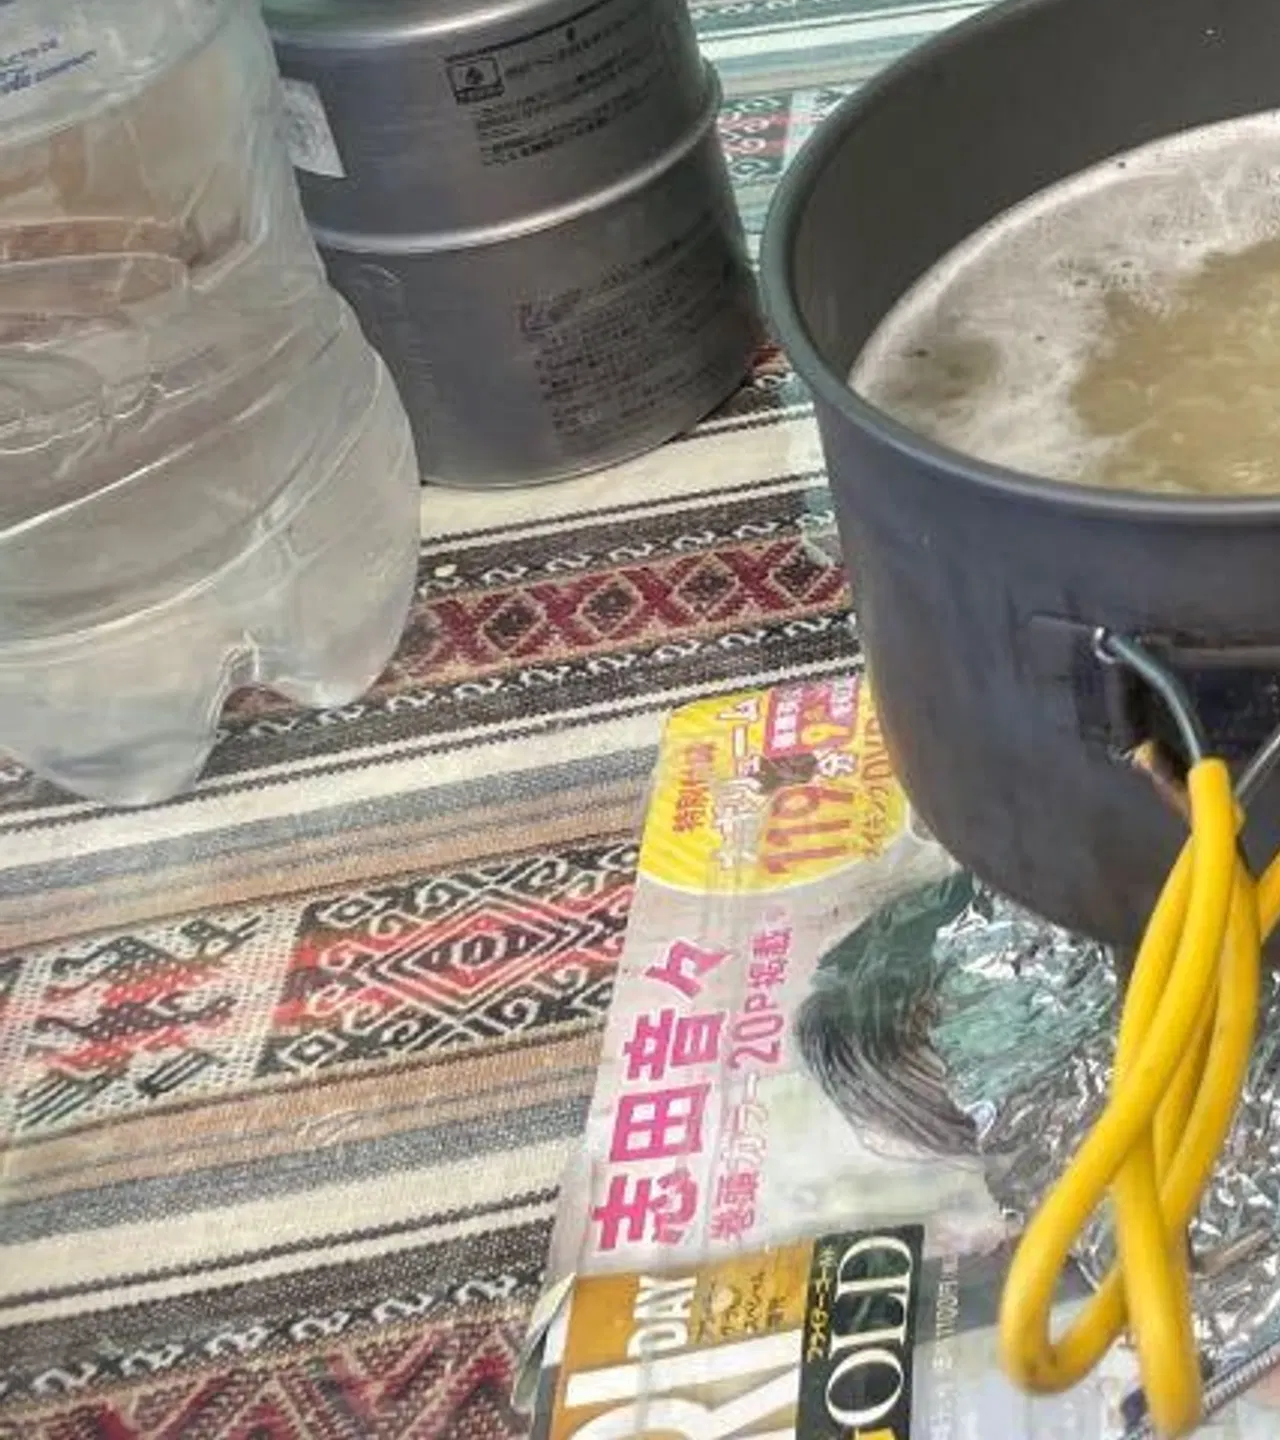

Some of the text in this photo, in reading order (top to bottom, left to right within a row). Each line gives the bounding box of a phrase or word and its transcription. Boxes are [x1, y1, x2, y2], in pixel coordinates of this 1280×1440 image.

[590, 937, 732, 1253] 志田音々
[824, 1236, 915, 1440] OLD
